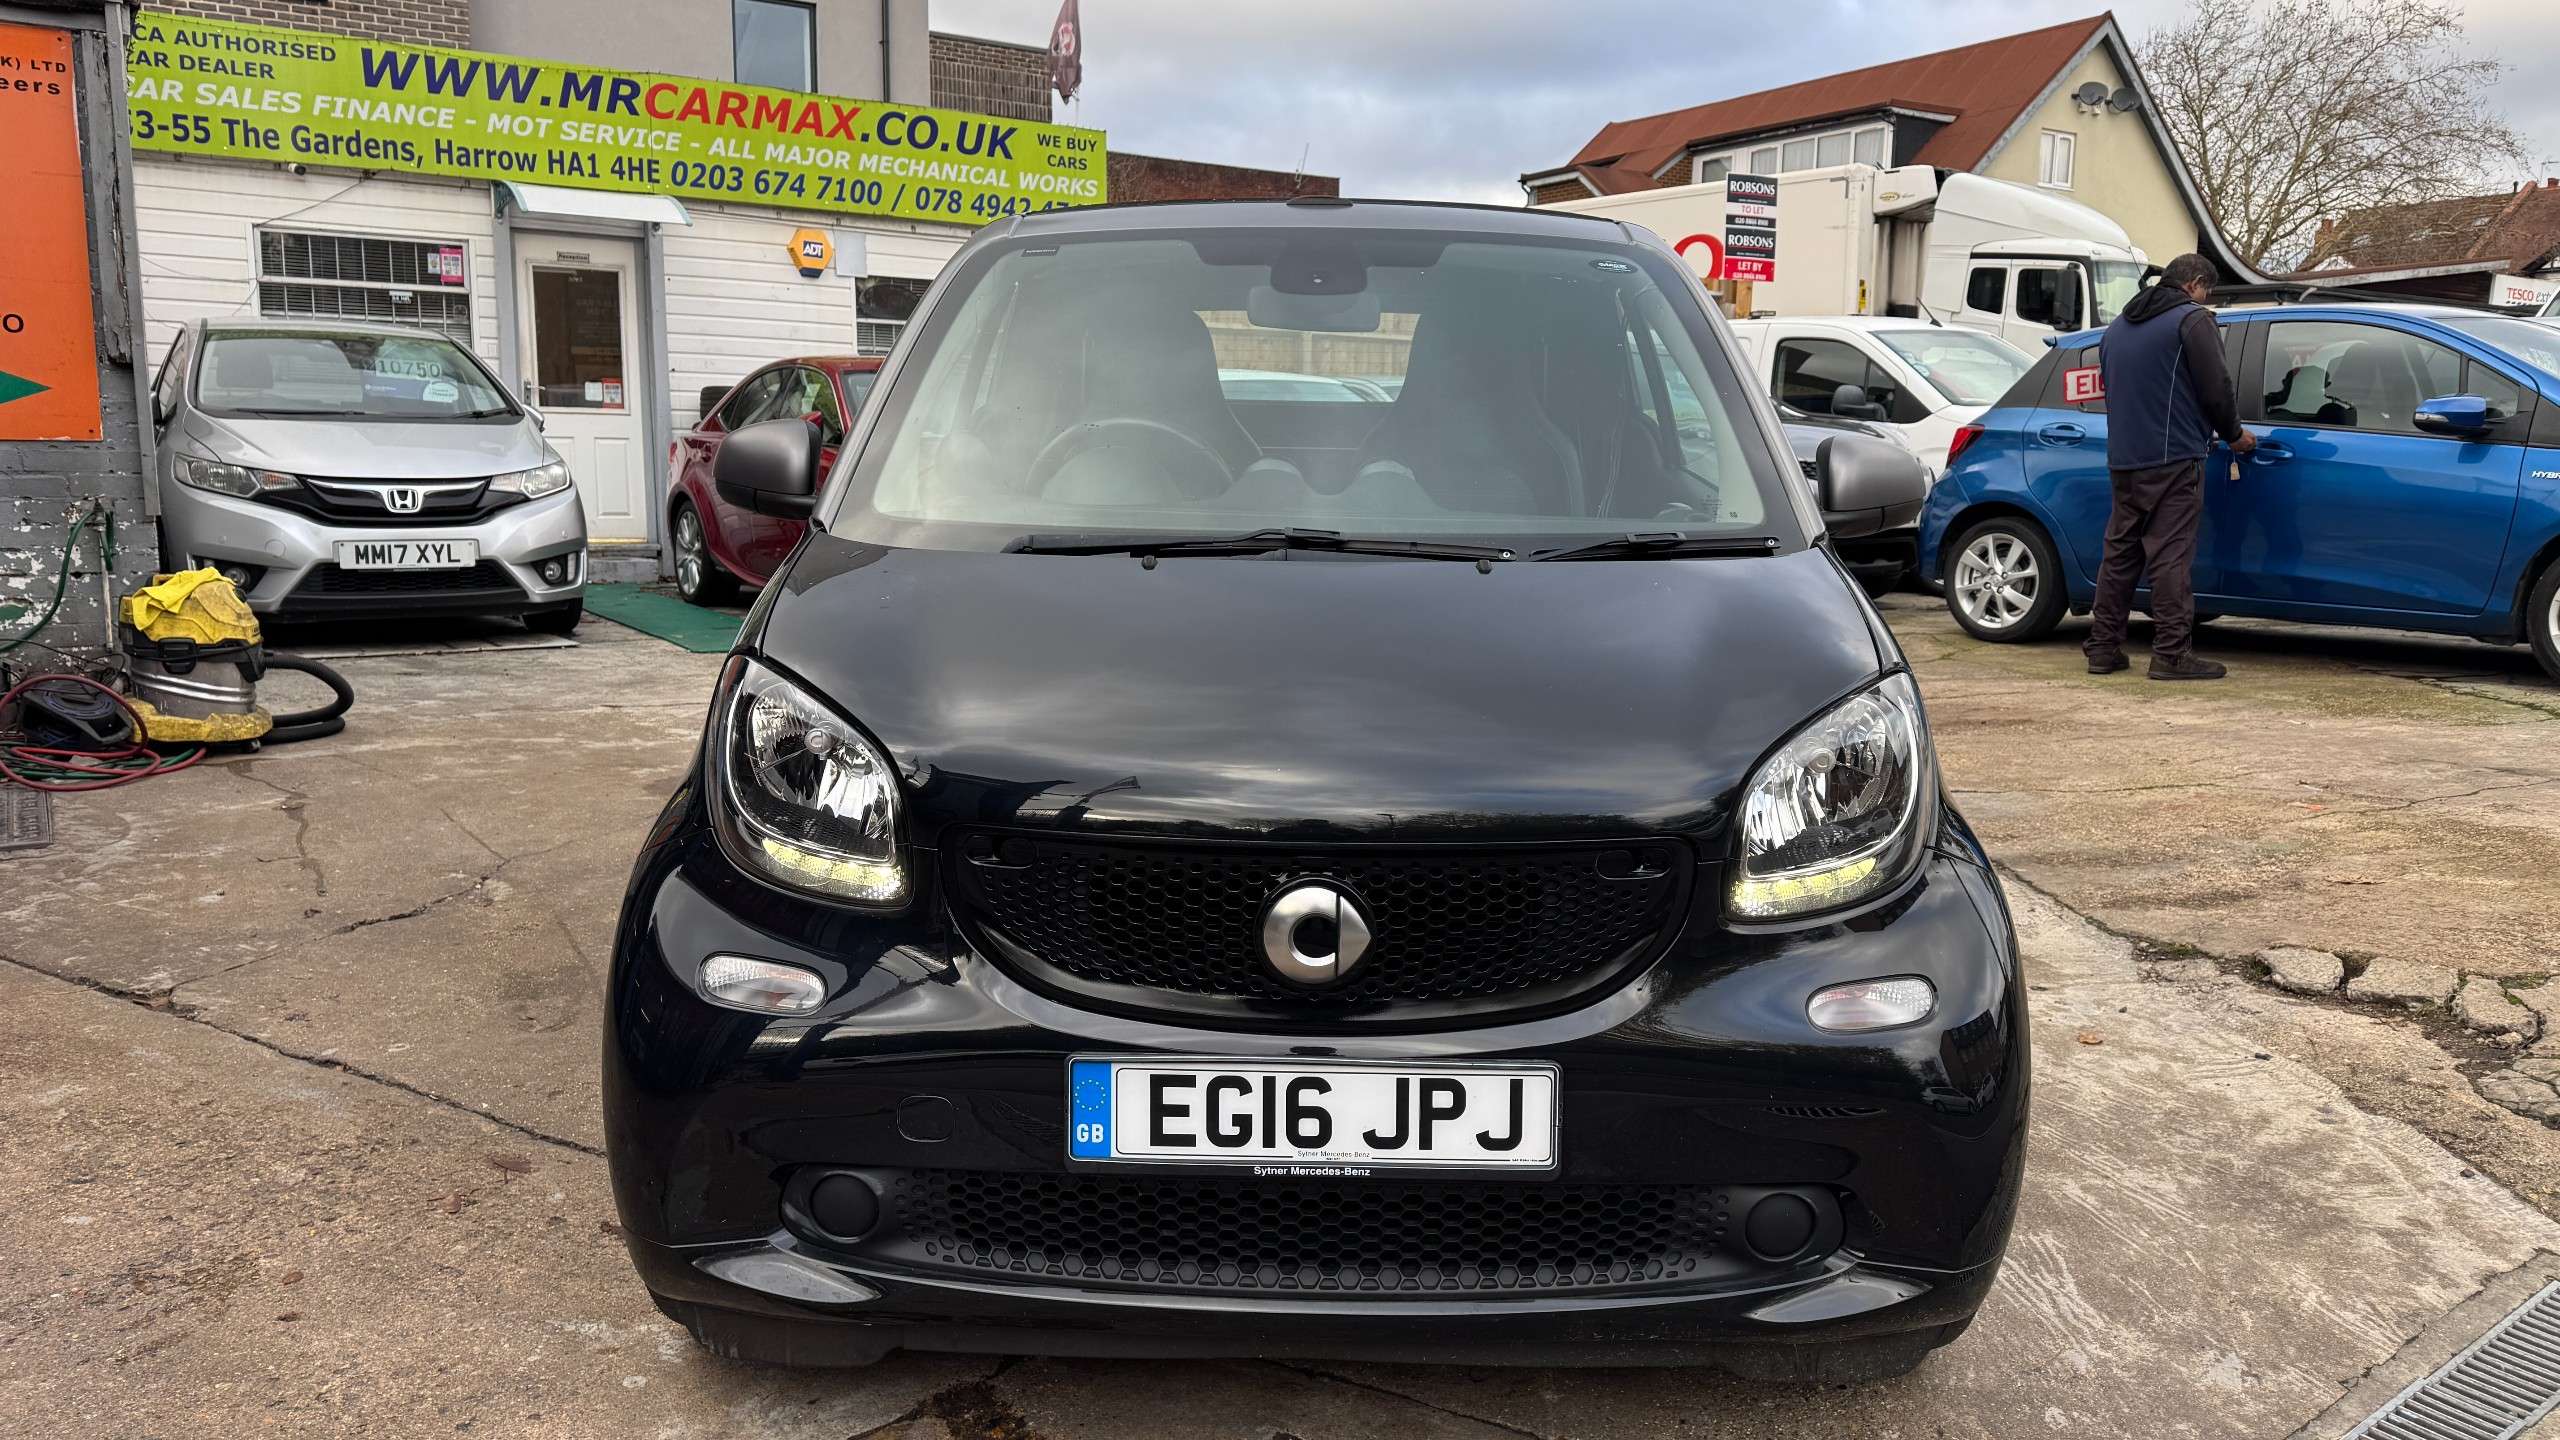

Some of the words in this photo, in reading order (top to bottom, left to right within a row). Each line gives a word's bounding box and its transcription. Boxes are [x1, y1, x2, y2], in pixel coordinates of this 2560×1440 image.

[174, 29, 336, 62] AUTHORISED
[30, 59, 66, 73] LTD
[179, 54, 275, 79] DEALER
[361, 48, 1018, 160] WWW.MRCARMAX.CO.UK
[196, 83, 302, 114] SALES
[313, 94, 456, 129] FINANCE
[487, 113, 553, 138] MOT
[560, 121, 682, 152] SERVICE
[708, 137, 755, 160] ALL
[764, 143, 850, 170] MAJOR
[858, 153, 1010, 188] MECHANICAL
[1018, 172, 1098, 198] WORKS
[1037, 132, 1062, 148] WE
[1066, 135, 1098, 152] BUY
[221, 117, 280, 150] The
[291, 125, 423, 168] Gardens,
[434, 138, 538, 173] Harrow
[547, 149, 600, 178] HA1
[610, 155, 661, 184] 4HE
[671, 160, 744, 191] 0203
[754, 169, 806, 198] 674
[815, 174, 882, 206] 7100
[891, 183, 906, 212] /
[916, 186, 963, 214] 078
[1047, 154, 1088, 171] CARS
[1730, 180, 1775, 196] ROBSONS
[1742, 205, 1752, 213] TO
[1753, 206, 1764, 215] LET
[803, 241, 823, 257] ADT
[1728, 234, 1774, 248] ROBSONS
[1737, 260, 1752, 271] LET
[2506, 287, 2534, 301] TESCO
[354, 544, 408, 565] MM17
[415, 543, 461, 564] XYL
[1150, 1073, 1333, 1149] EG16
[1362, 1077, 1524, 1151] JPJ
[1076, 1123, 1104, 1143] GB
[1253, 1166, 1288, 1177] Sytner
[1290, 1166, 1371, 1177] Mercedes-Benz
